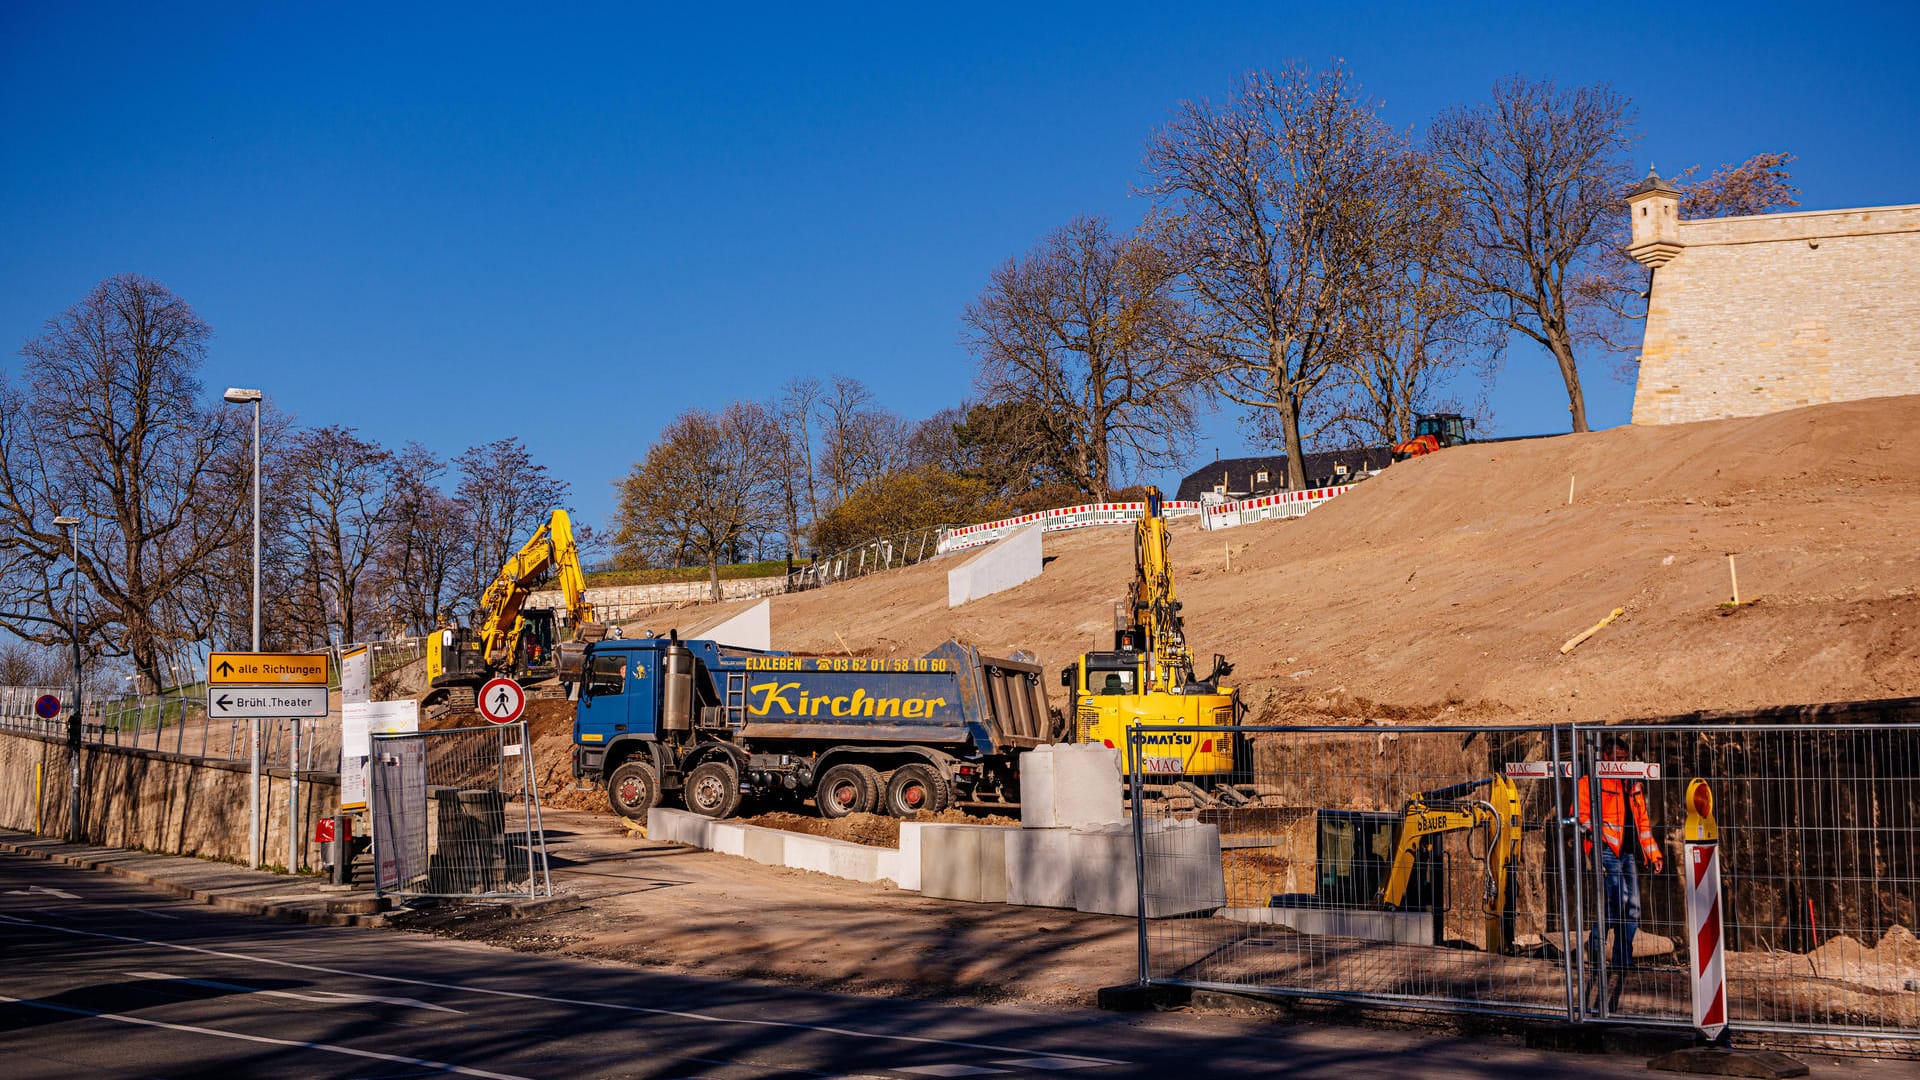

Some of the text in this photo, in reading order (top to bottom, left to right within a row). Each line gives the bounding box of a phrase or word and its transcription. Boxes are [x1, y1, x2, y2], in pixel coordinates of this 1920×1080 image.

[238, 664, 322, 676] alle Richtungen
[746, 657, 801, 671] ELXLEBEN
[833, 658, 848, 671] 03
[852, 658, 867, 671] 62
[894, 659, 908, 672] 58
[914, 659, 927, 672] 10
[931, 659, 946, 672] 60
[237, 697, 266, 707] Brühl
[749, 682, 947, 719] Kirchner
[1149, 759, 1180, 773] MAC
[1507, 763, 1531, 773] MAC
[1600, 762, 1628, 772] MAC
